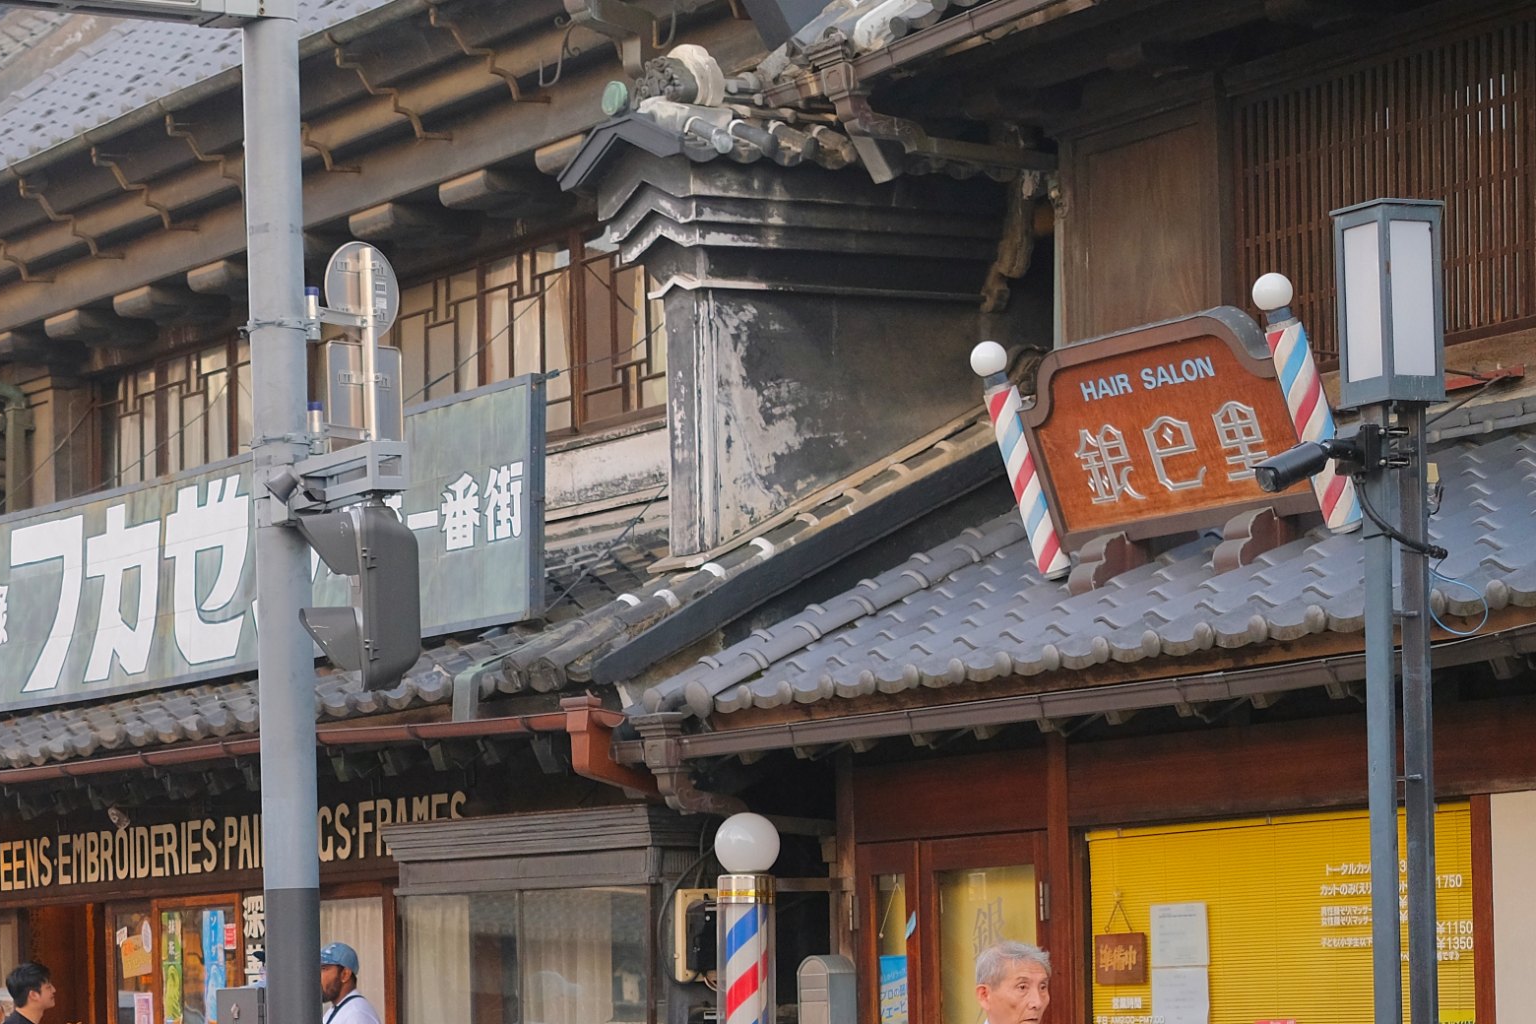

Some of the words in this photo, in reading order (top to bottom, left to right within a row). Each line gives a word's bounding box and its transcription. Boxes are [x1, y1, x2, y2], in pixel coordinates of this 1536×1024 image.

[1080, 373, 1133, 401] HAIR
[1141, 356, 1215, 390] SALON
[10, 474, 259, 693] フカゼ
[224, 803, 352, 870] PAIGS
